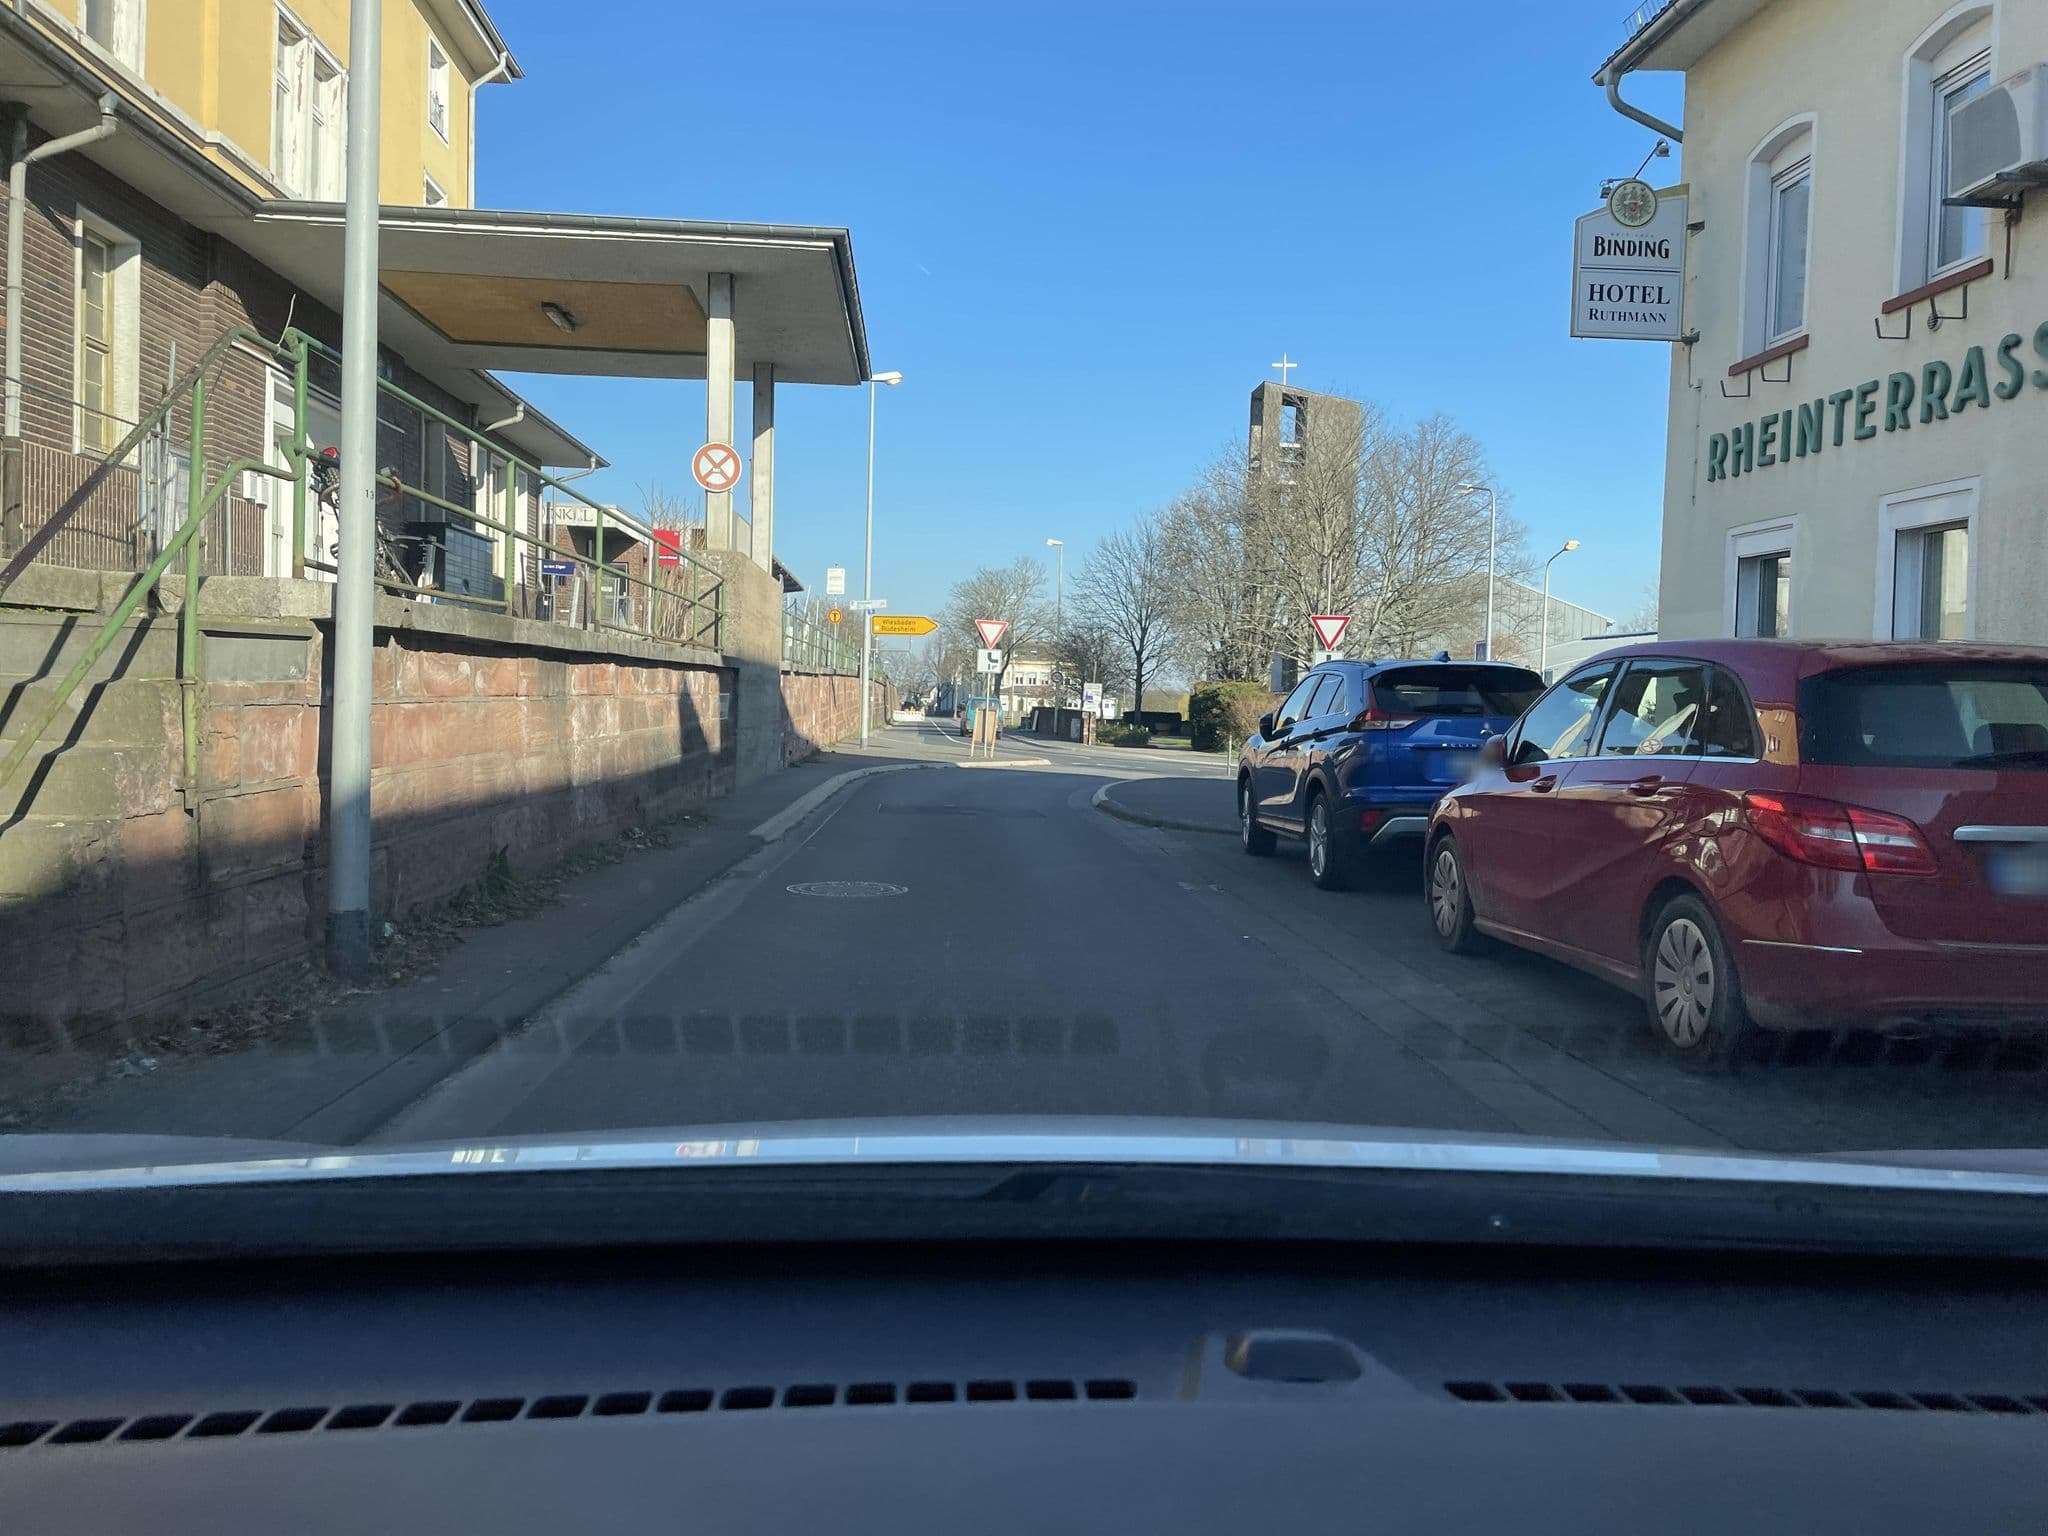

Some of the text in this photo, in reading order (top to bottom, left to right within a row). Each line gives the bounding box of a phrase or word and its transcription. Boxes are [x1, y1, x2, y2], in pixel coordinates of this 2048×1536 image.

[1594, 235, 1670, 259] BINDING
[1588, 283, 1671, 305] HOTEL
[1588, 307, 1668, 324] RUTHMANN
